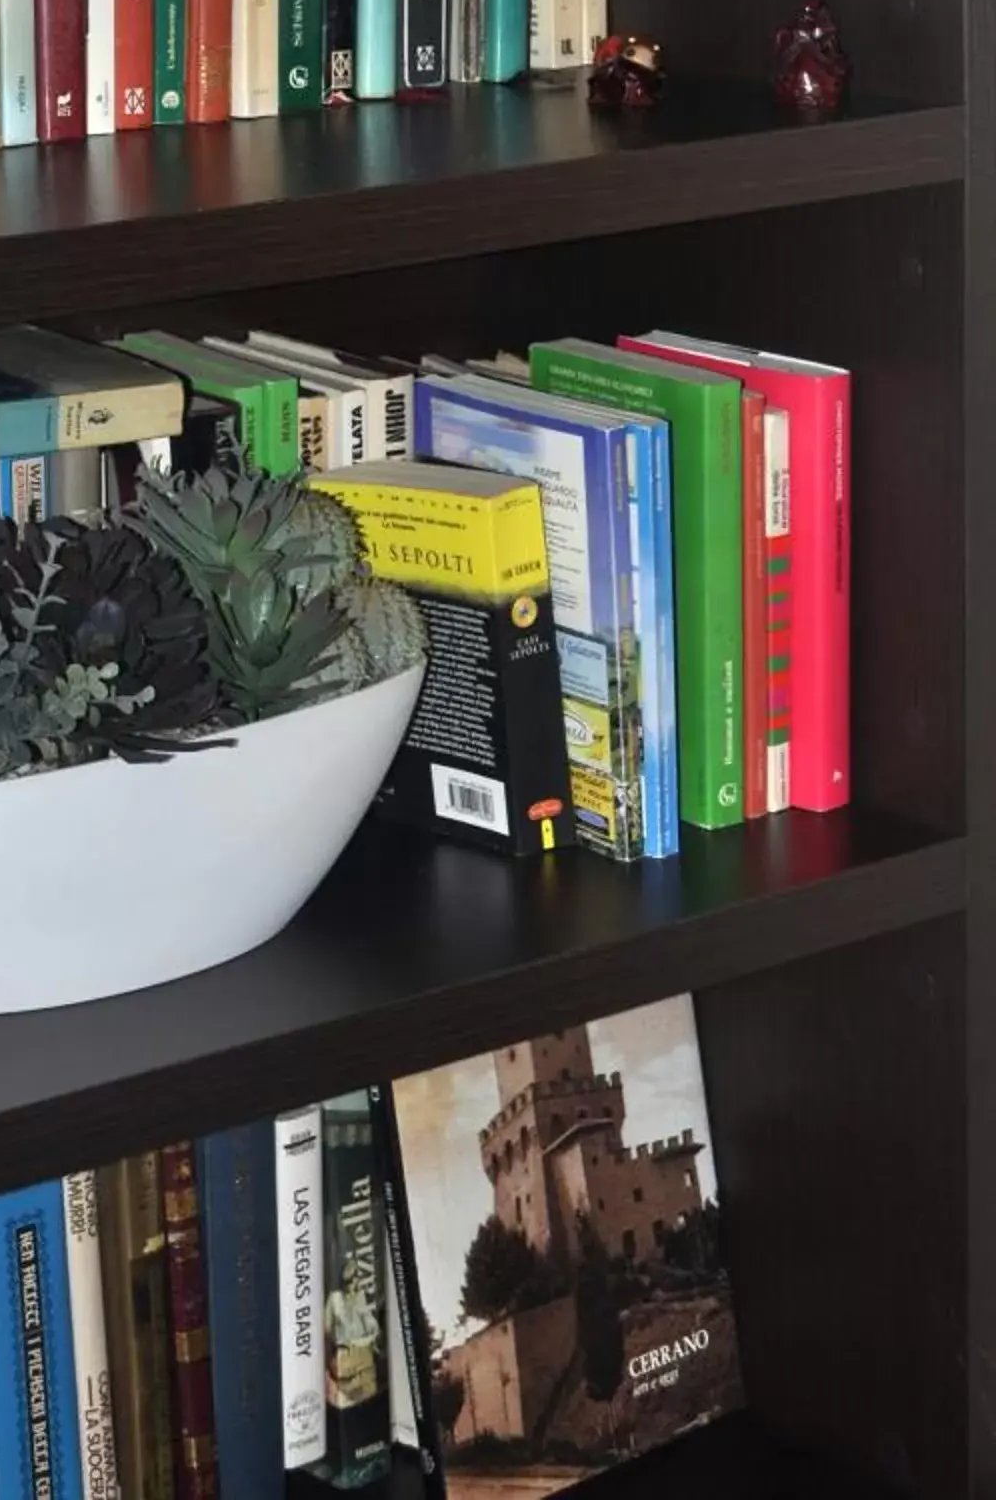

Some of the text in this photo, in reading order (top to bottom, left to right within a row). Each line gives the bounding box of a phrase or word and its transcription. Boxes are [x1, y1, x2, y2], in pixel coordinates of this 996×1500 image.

[385, 388, 406, 442] JOHN
[294, 1186, 312, 1358] LAS VEGAS BABY
[628, 1328, 710, 1379] CERRANO
